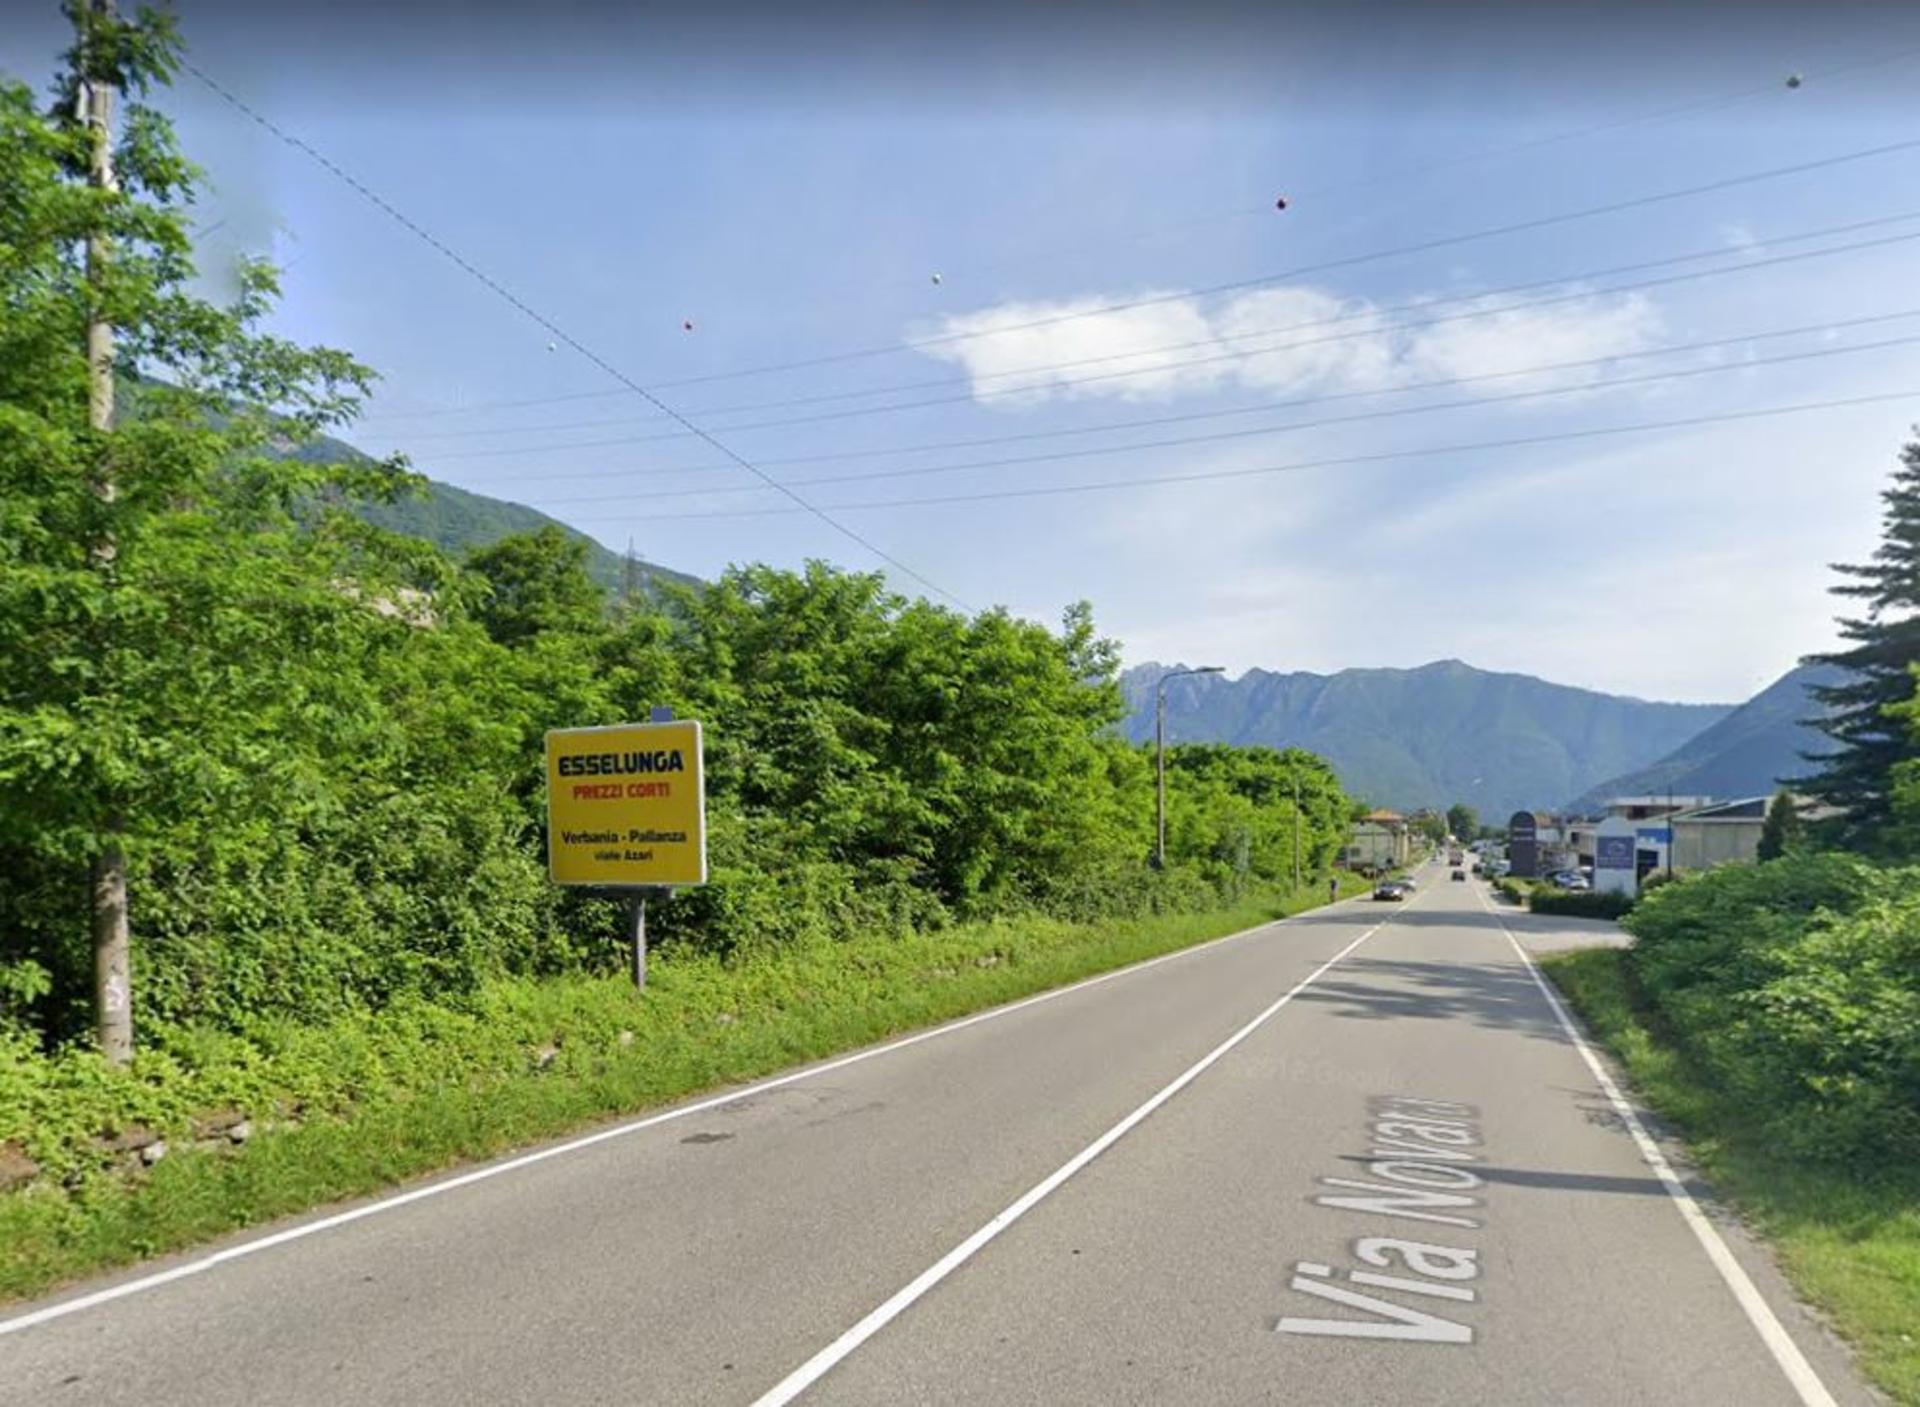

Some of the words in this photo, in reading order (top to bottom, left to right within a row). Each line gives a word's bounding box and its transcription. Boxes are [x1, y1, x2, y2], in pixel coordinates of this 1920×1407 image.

[559, 750, 683, 776] ESSELUNGA
[572, 784, 623, 800] PREZZI
[627, 782, 671, 798] CORTI
[561, 829, 619, 845] Verbania
[629, 828, 687, 843] Pallanza
[624, 849, 653, 861] Azari
